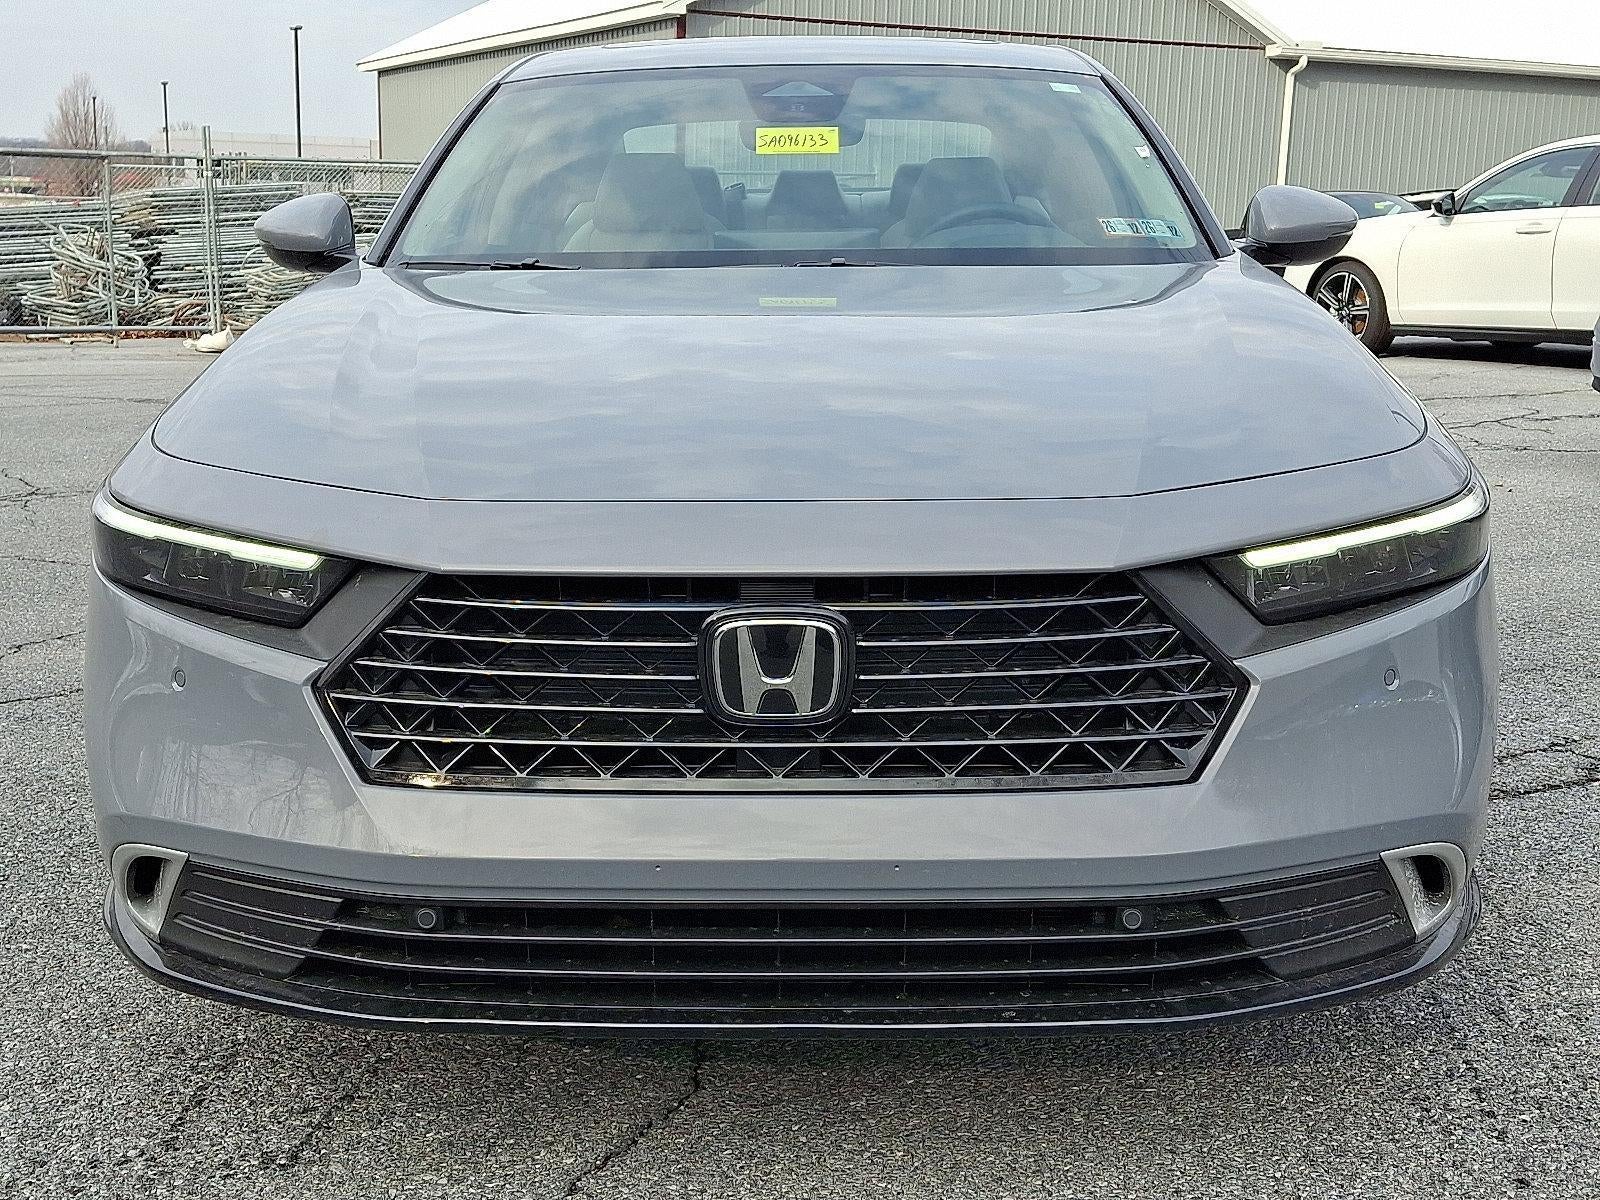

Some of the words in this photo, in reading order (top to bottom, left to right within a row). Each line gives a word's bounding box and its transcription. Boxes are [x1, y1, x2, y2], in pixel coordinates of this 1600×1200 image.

[758, 133, 829, 147] SA096133
[1102, 220, 1117, 233] 26
[1127, 222, 1143, 235] 12
[1141, 220, 1157, 234] 26
